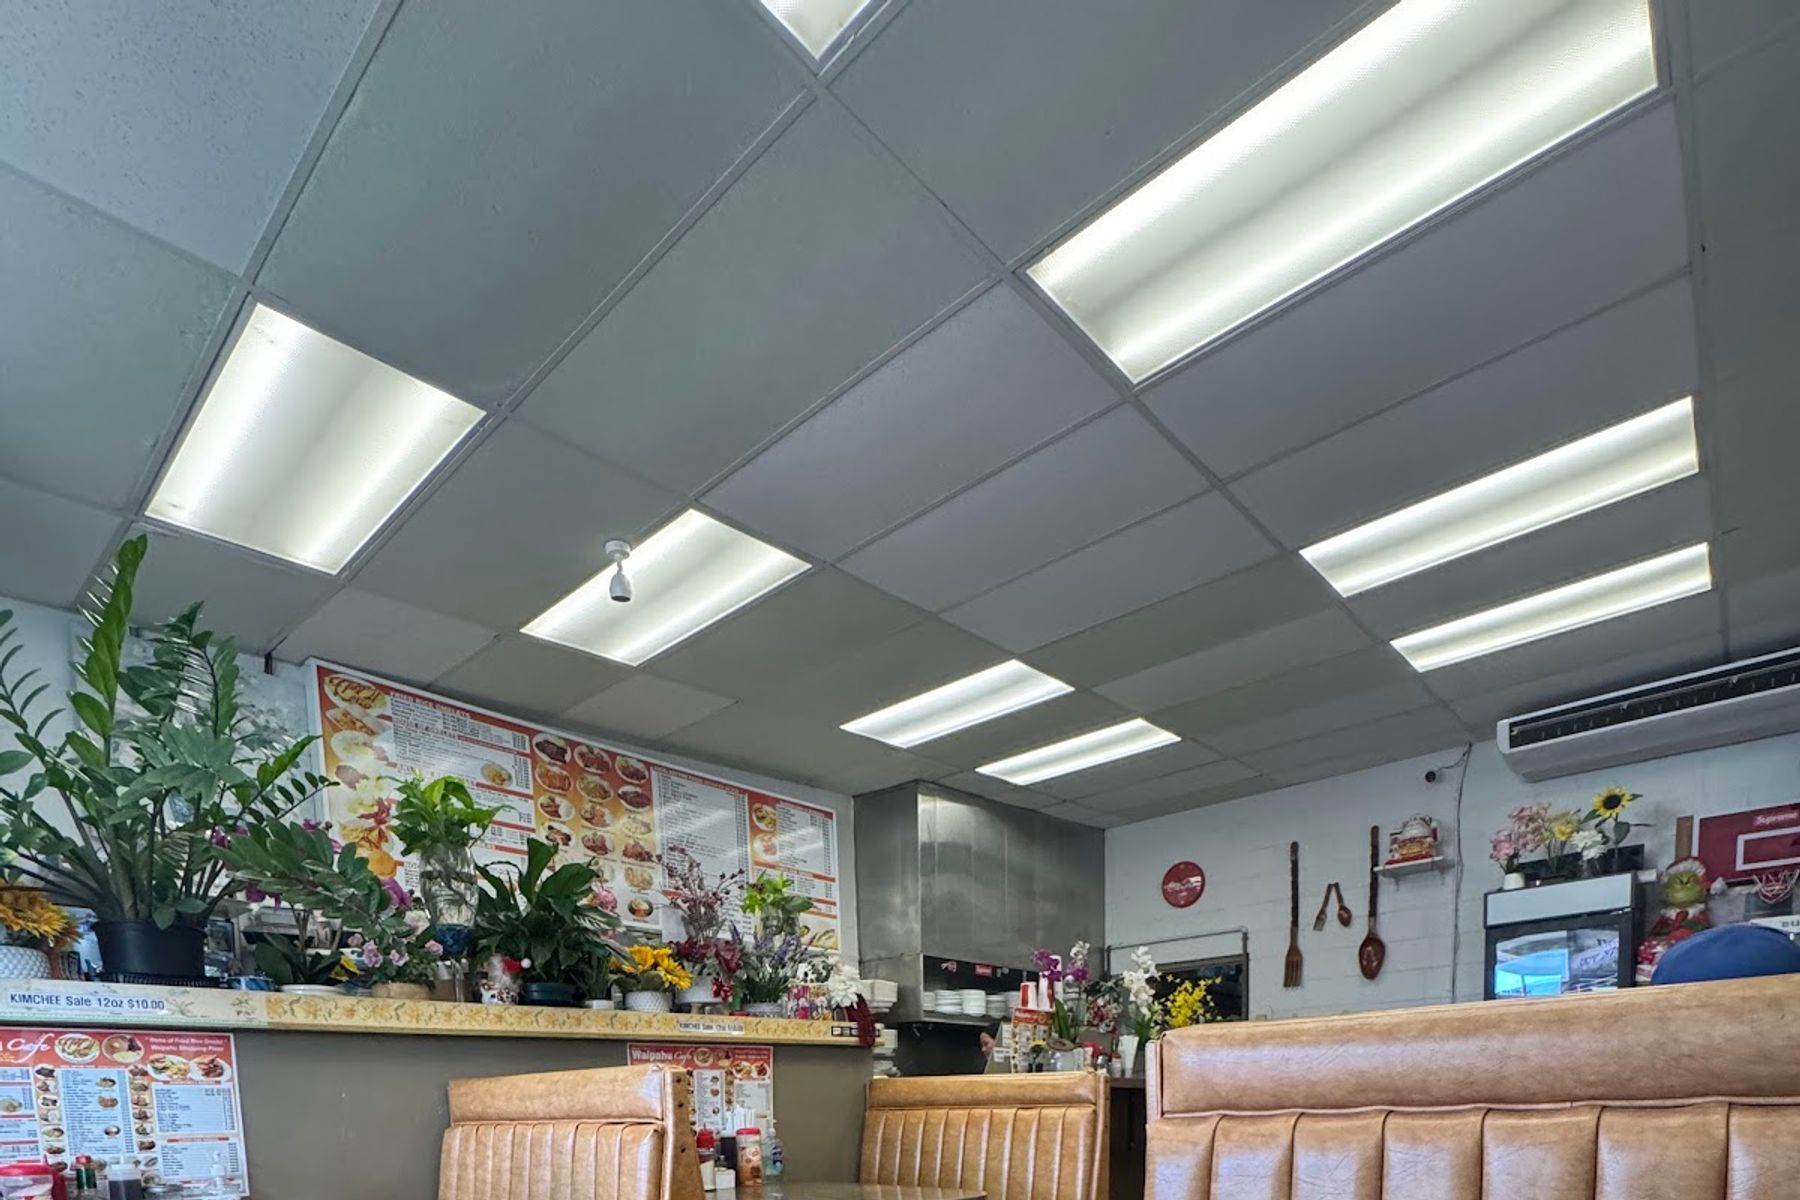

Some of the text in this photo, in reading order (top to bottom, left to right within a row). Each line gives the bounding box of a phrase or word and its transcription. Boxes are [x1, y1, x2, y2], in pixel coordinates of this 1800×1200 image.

[10, 993, 165, 1010] KIMCHEE Sale 12oz $10.00
[631, 1048, 673, 1062] Waipahu
